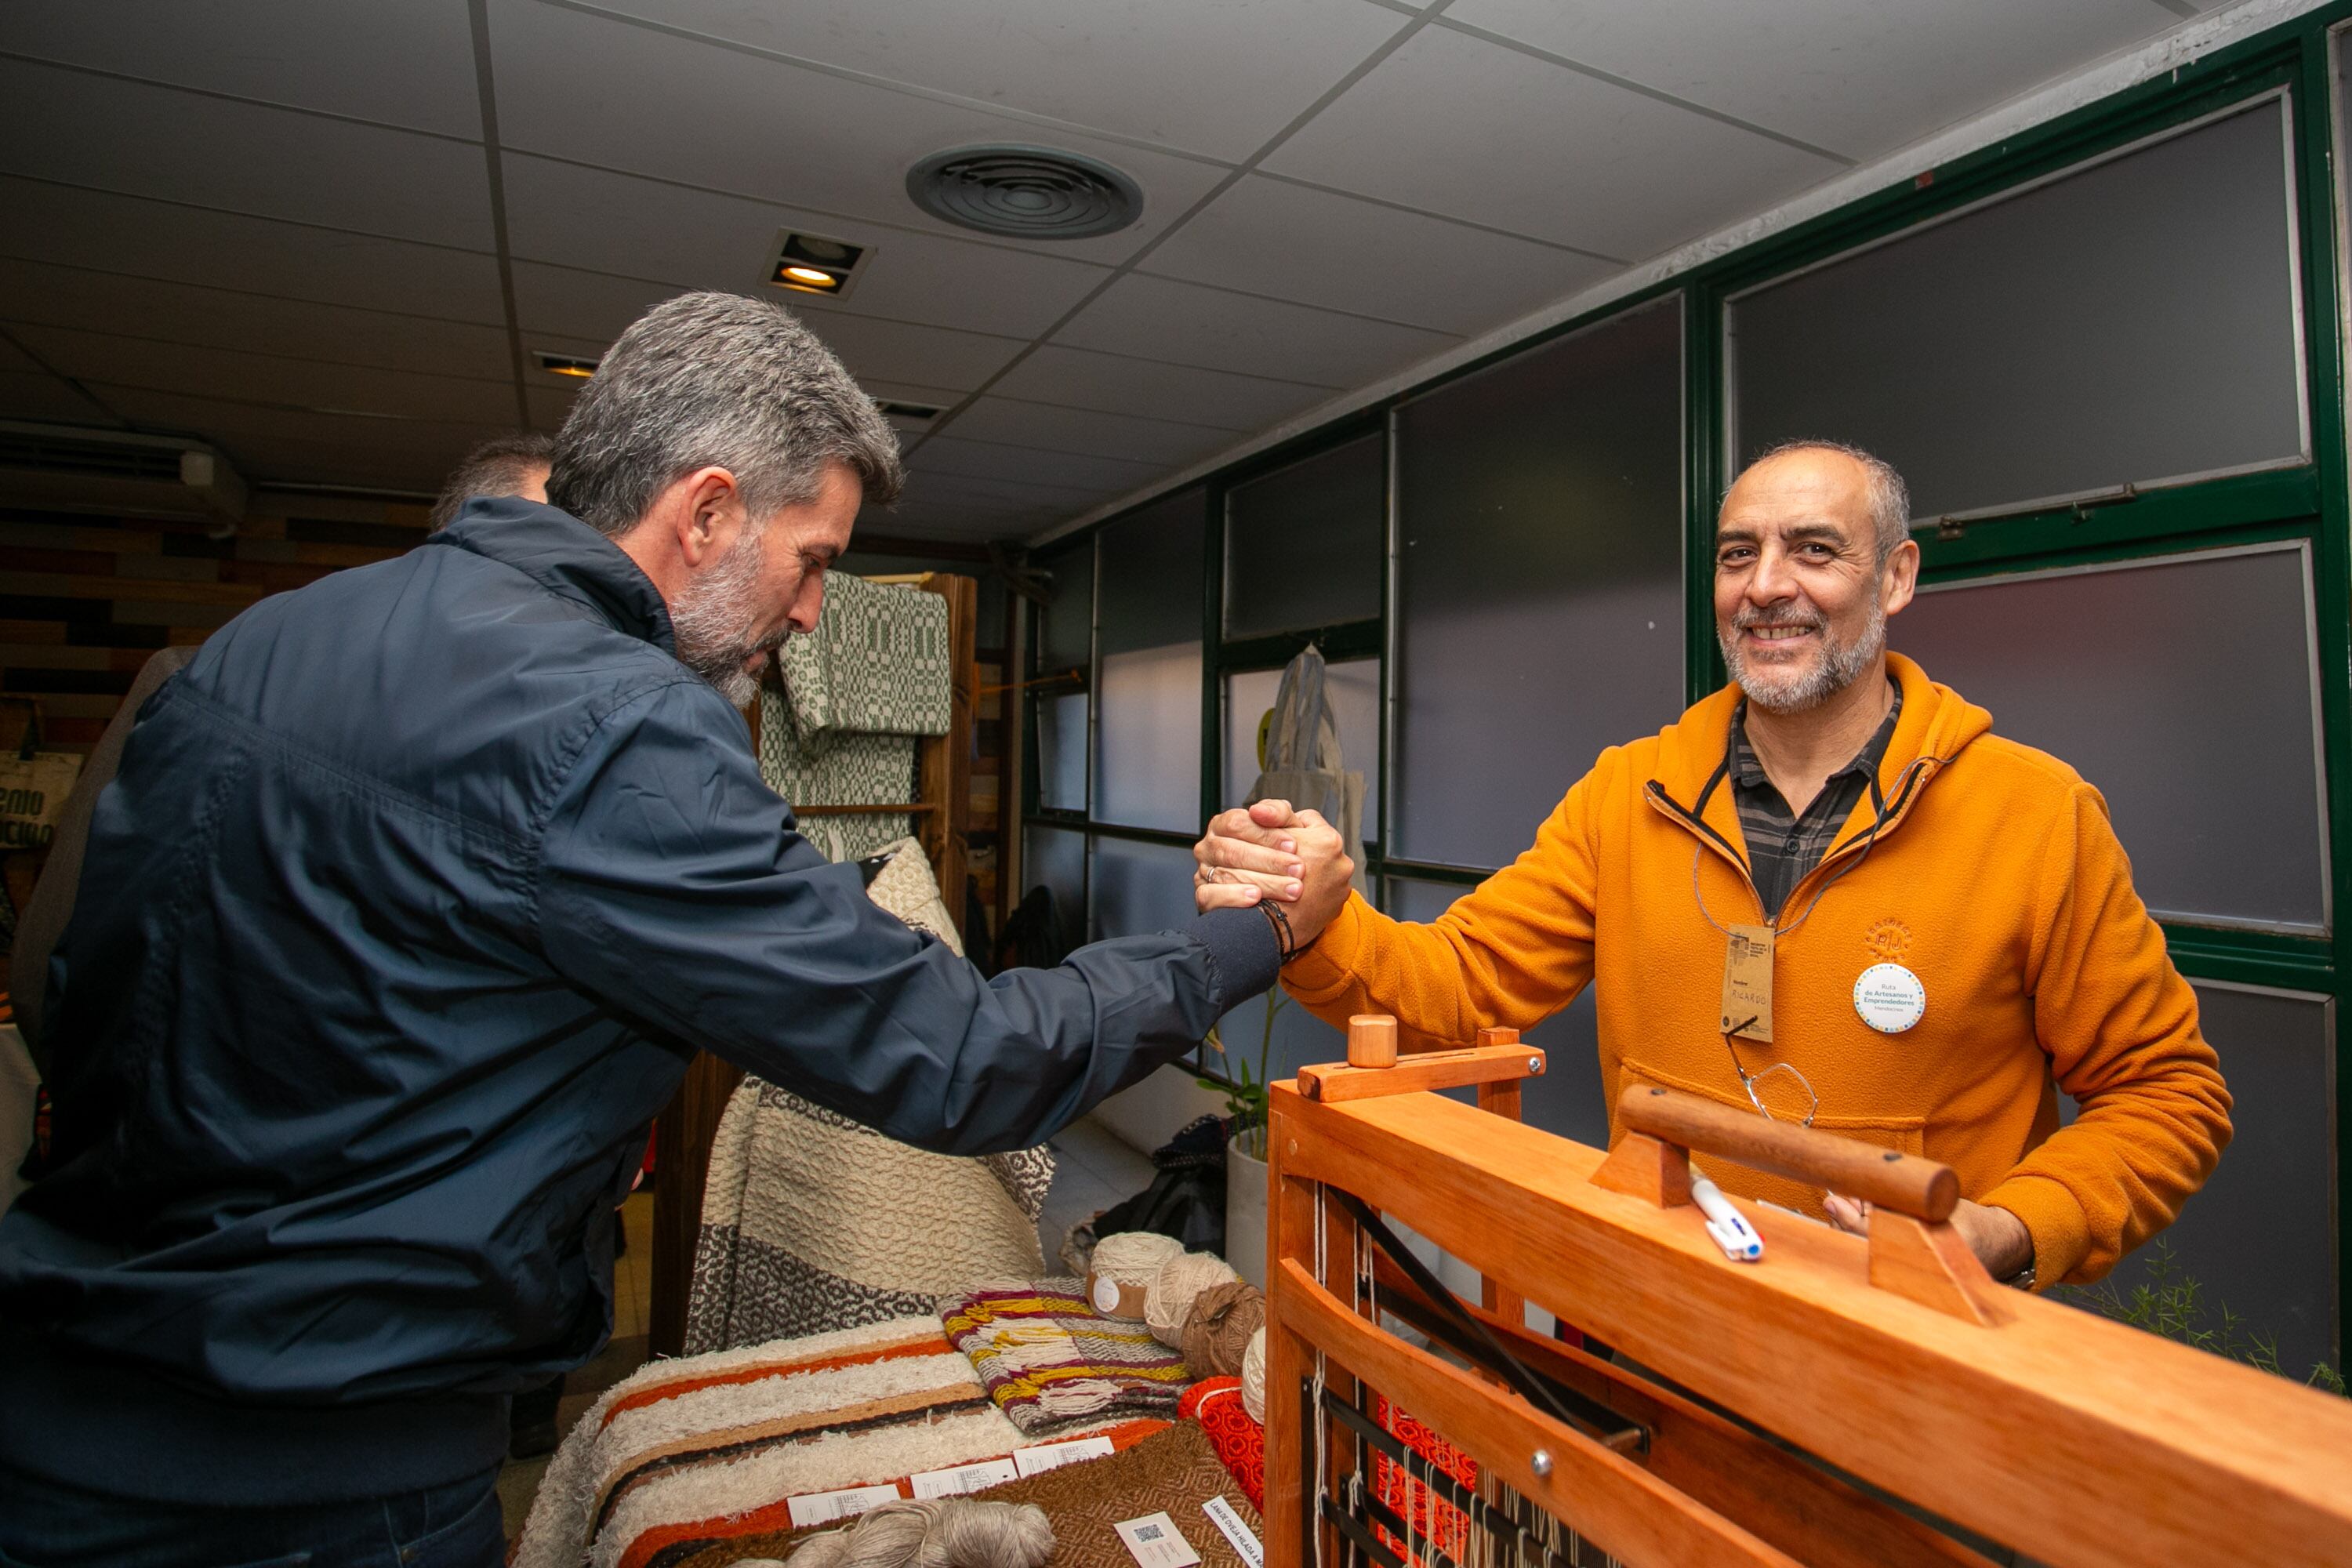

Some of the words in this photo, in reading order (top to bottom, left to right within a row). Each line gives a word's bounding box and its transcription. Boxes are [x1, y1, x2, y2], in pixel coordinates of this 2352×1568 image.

[1732, 989, 1766, 1004] RICARDO
[1864, 996, 1915, 1006] Emprendedores
[1210, 1502, 1221, 1515] LANA
[1225, 1519, 1240, 1537] OVEJA
[1237, 1535, 1255, 1555] HILADA
